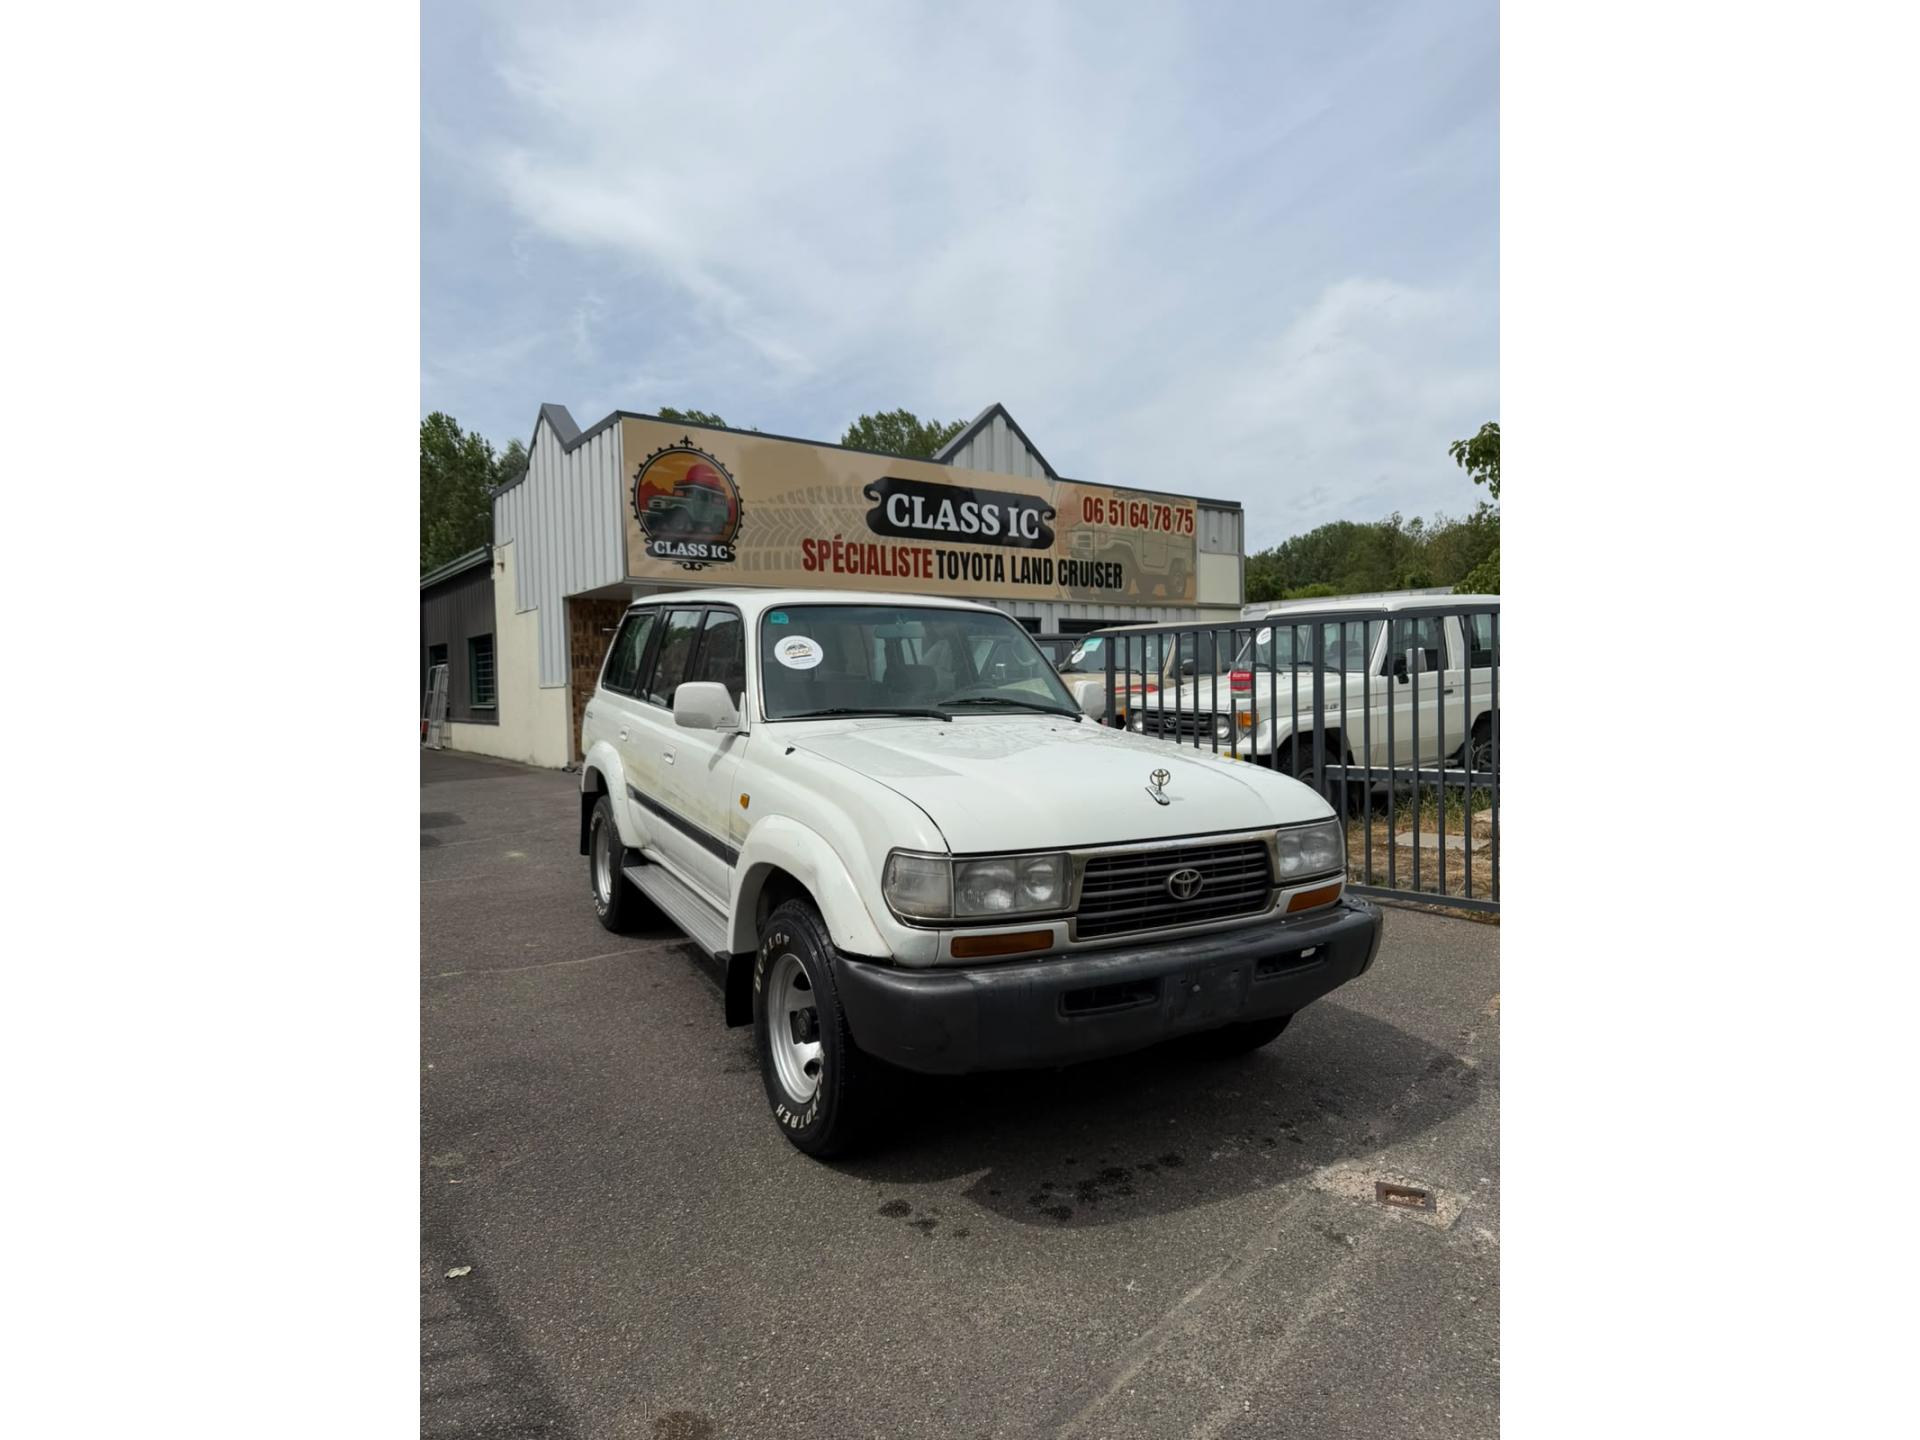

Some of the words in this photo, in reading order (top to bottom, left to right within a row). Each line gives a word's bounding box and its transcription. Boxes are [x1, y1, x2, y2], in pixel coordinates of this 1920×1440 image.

[886, 493, 1001, 536] CLASS
[1007, 507, 1040, 540] IC
[1083, 496, 1104, 524] 06
[1108, 499, 1125, 527] 51
[1130, 502, 1149, 529] 64
[1153, 505, 1171, 531] 78
[1176, 508, 1194, 534] 75
[653, 540, 708, 557] CLASS
[711, 545, 728, 559] IC
[802, 533, 933, 579] SPÉCIALISTE
[936, 549, 1005, 583] TOYOTA
[1010, 555, 1054, 585] LAND
[1058, 559, 1123, 589] CRUISER
